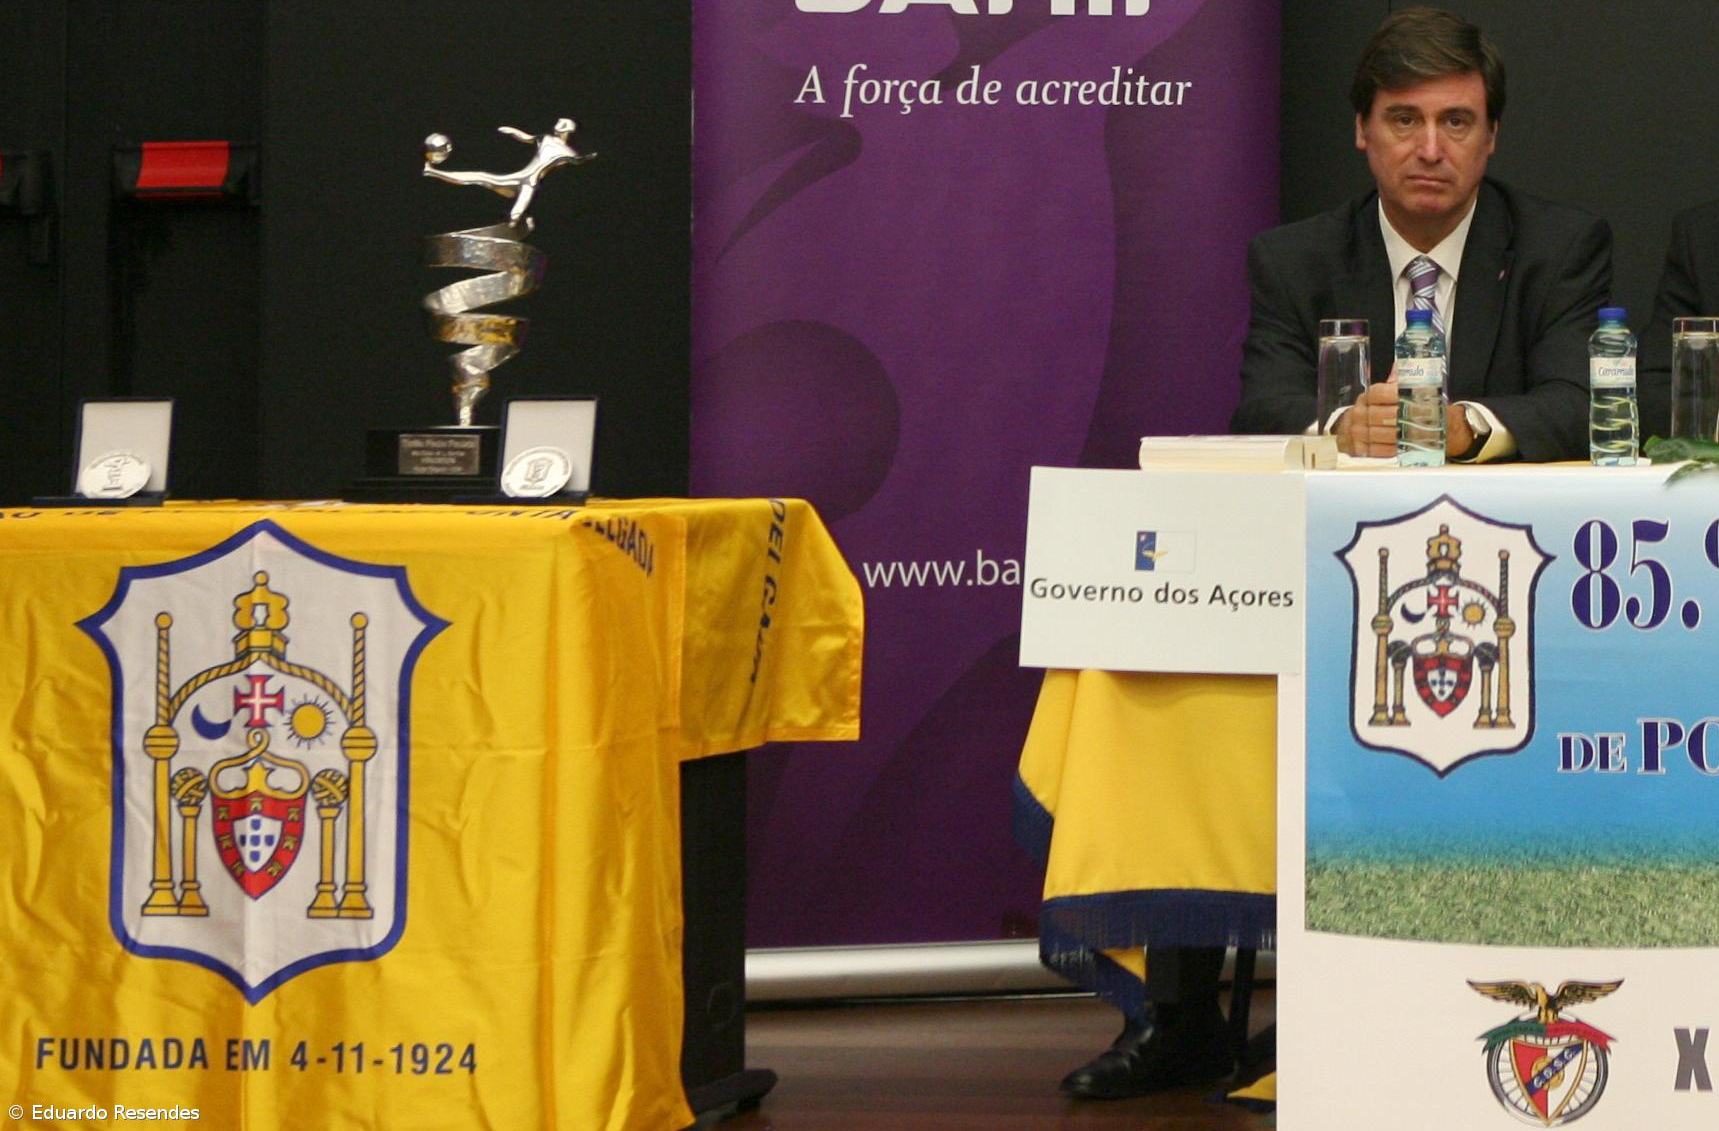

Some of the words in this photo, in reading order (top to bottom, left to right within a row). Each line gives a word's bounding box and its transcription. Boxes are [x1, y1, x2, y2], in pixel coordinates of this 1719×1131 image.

[795, 65, 826, 105] A
[840, 63, 941, 118] força
[956, 65, 1002, 106] de
[1015, 65, 1193, 107] acreditar
[1030, 577, 1144, 603] Governo
[1154, 581, 1199, 605] dos
[1209, 584, 1294, 612] Açores
[1557, 733, 1627, 773] DE
[35, 1036, 209, 1071] FUNDADA
[225, 1039, 271, 1072] EM
[290, 1042, 479, 1076] 4-11-1924
